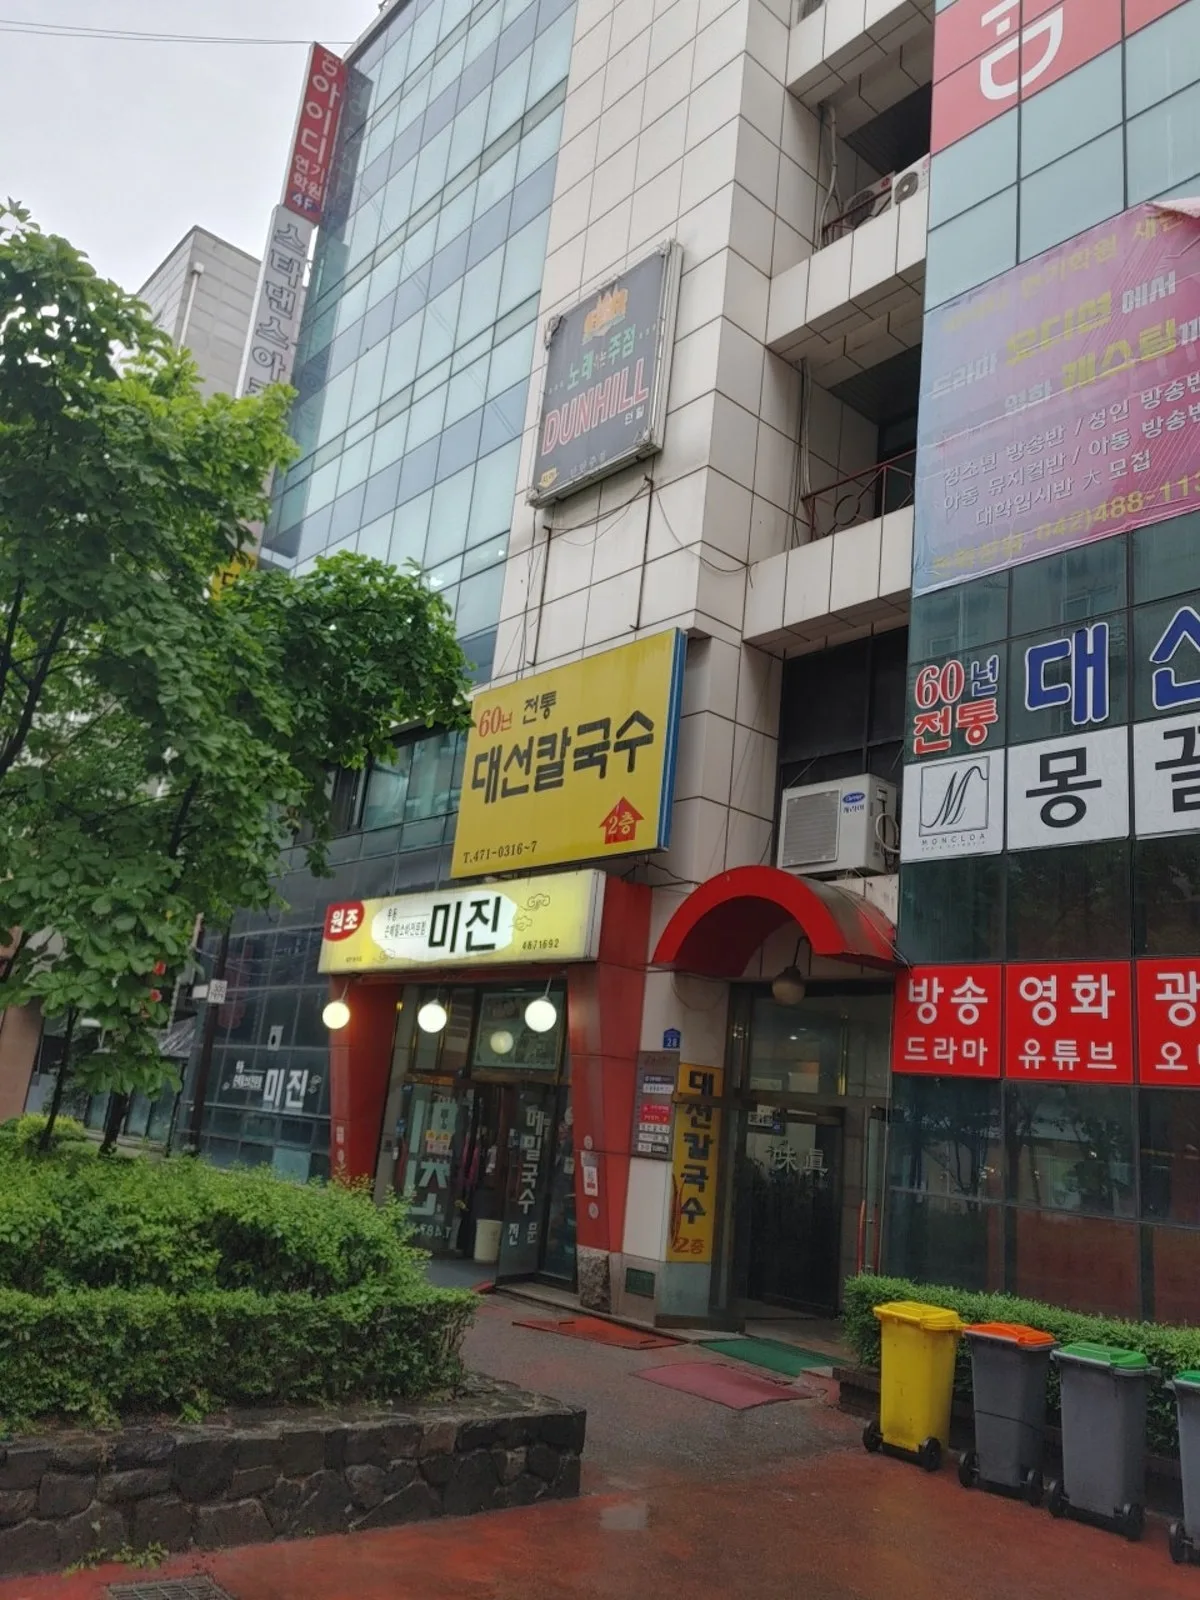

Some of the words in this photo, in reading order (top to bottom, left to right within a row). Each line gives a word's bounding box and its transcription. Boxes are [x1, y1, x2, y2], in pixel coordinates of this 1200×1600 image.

[930, 352, 998, 398] 드라마
[541, 358, 649, 456] DUNHILL
[943, 452, 998, 488] 청소년
[1005, 424, 1066, 462] 방송반
[1087, 399, 1130, 431] 성인
[943, 486, 980, 512] 아동
[987, 451, 1067, 497] 뮤지컬반
[1088, 428, 1132, 456] 아동
[975, 476, 1075, 526] 대학입시반
[1108, 448, 1152, 480] 모집
[522, 690, 557, 725] 전통
[913, 698, 999, 755] 전통
[471, 710, 655, 805] 대선칼국수
[607, 811, 635, 835] 2층
[330, 907, 359, 934] 원조
[428, 896, 502, 953] 미진
[908, 976, 988, 1025] 방송
[1019, 973, 1116, 1026] 영화
[904, 1036, 988, 1067] 드라마
[1018, 1038, 1117, 1071] 유튜브
[1155, 1041, 1200, 1071] 오
[263, 1068, 309, 1110] 미진
[518, 1110, 544, 1215] 메밀국수
